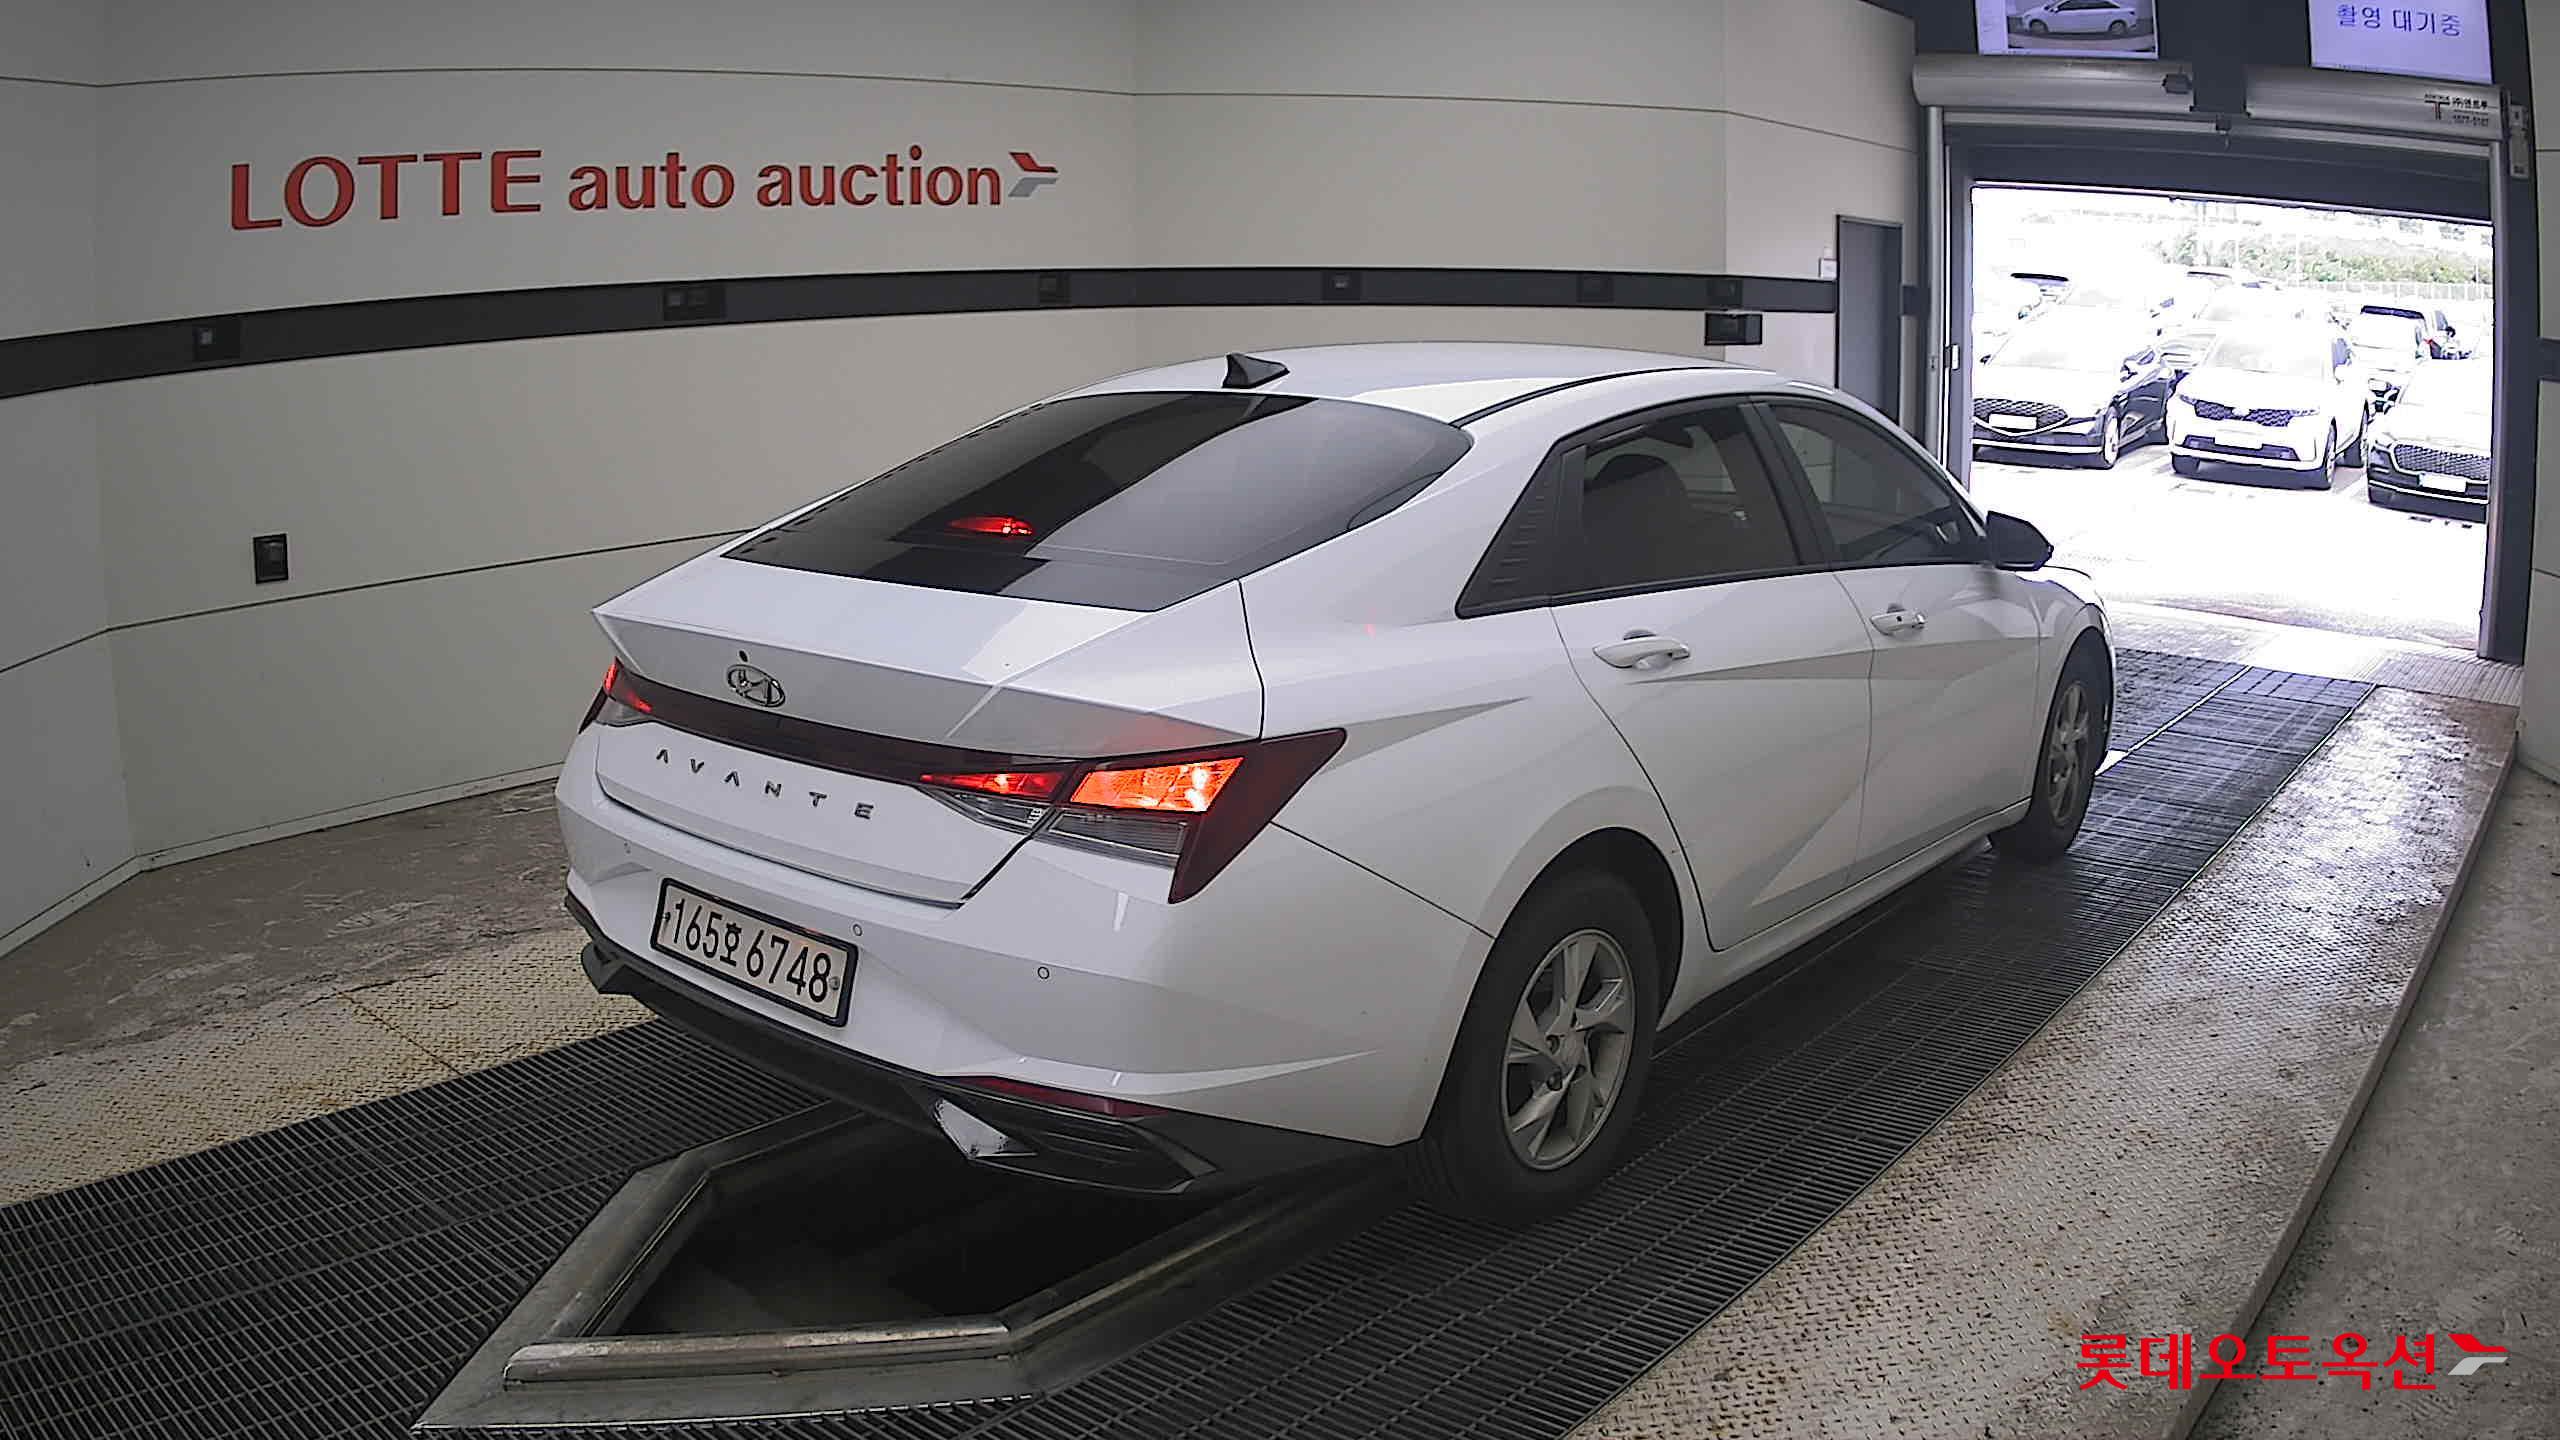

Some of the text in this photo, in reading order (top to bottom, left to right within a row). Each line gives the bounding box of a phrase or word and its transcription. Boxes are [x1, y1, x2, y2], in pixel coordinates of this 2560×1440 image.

[2337, 4, 2461, 37] 촬영 대기중
[231, 145, 1002, 230] LOTTE auto auction
[656, 748, 874, 820] AVANTE
